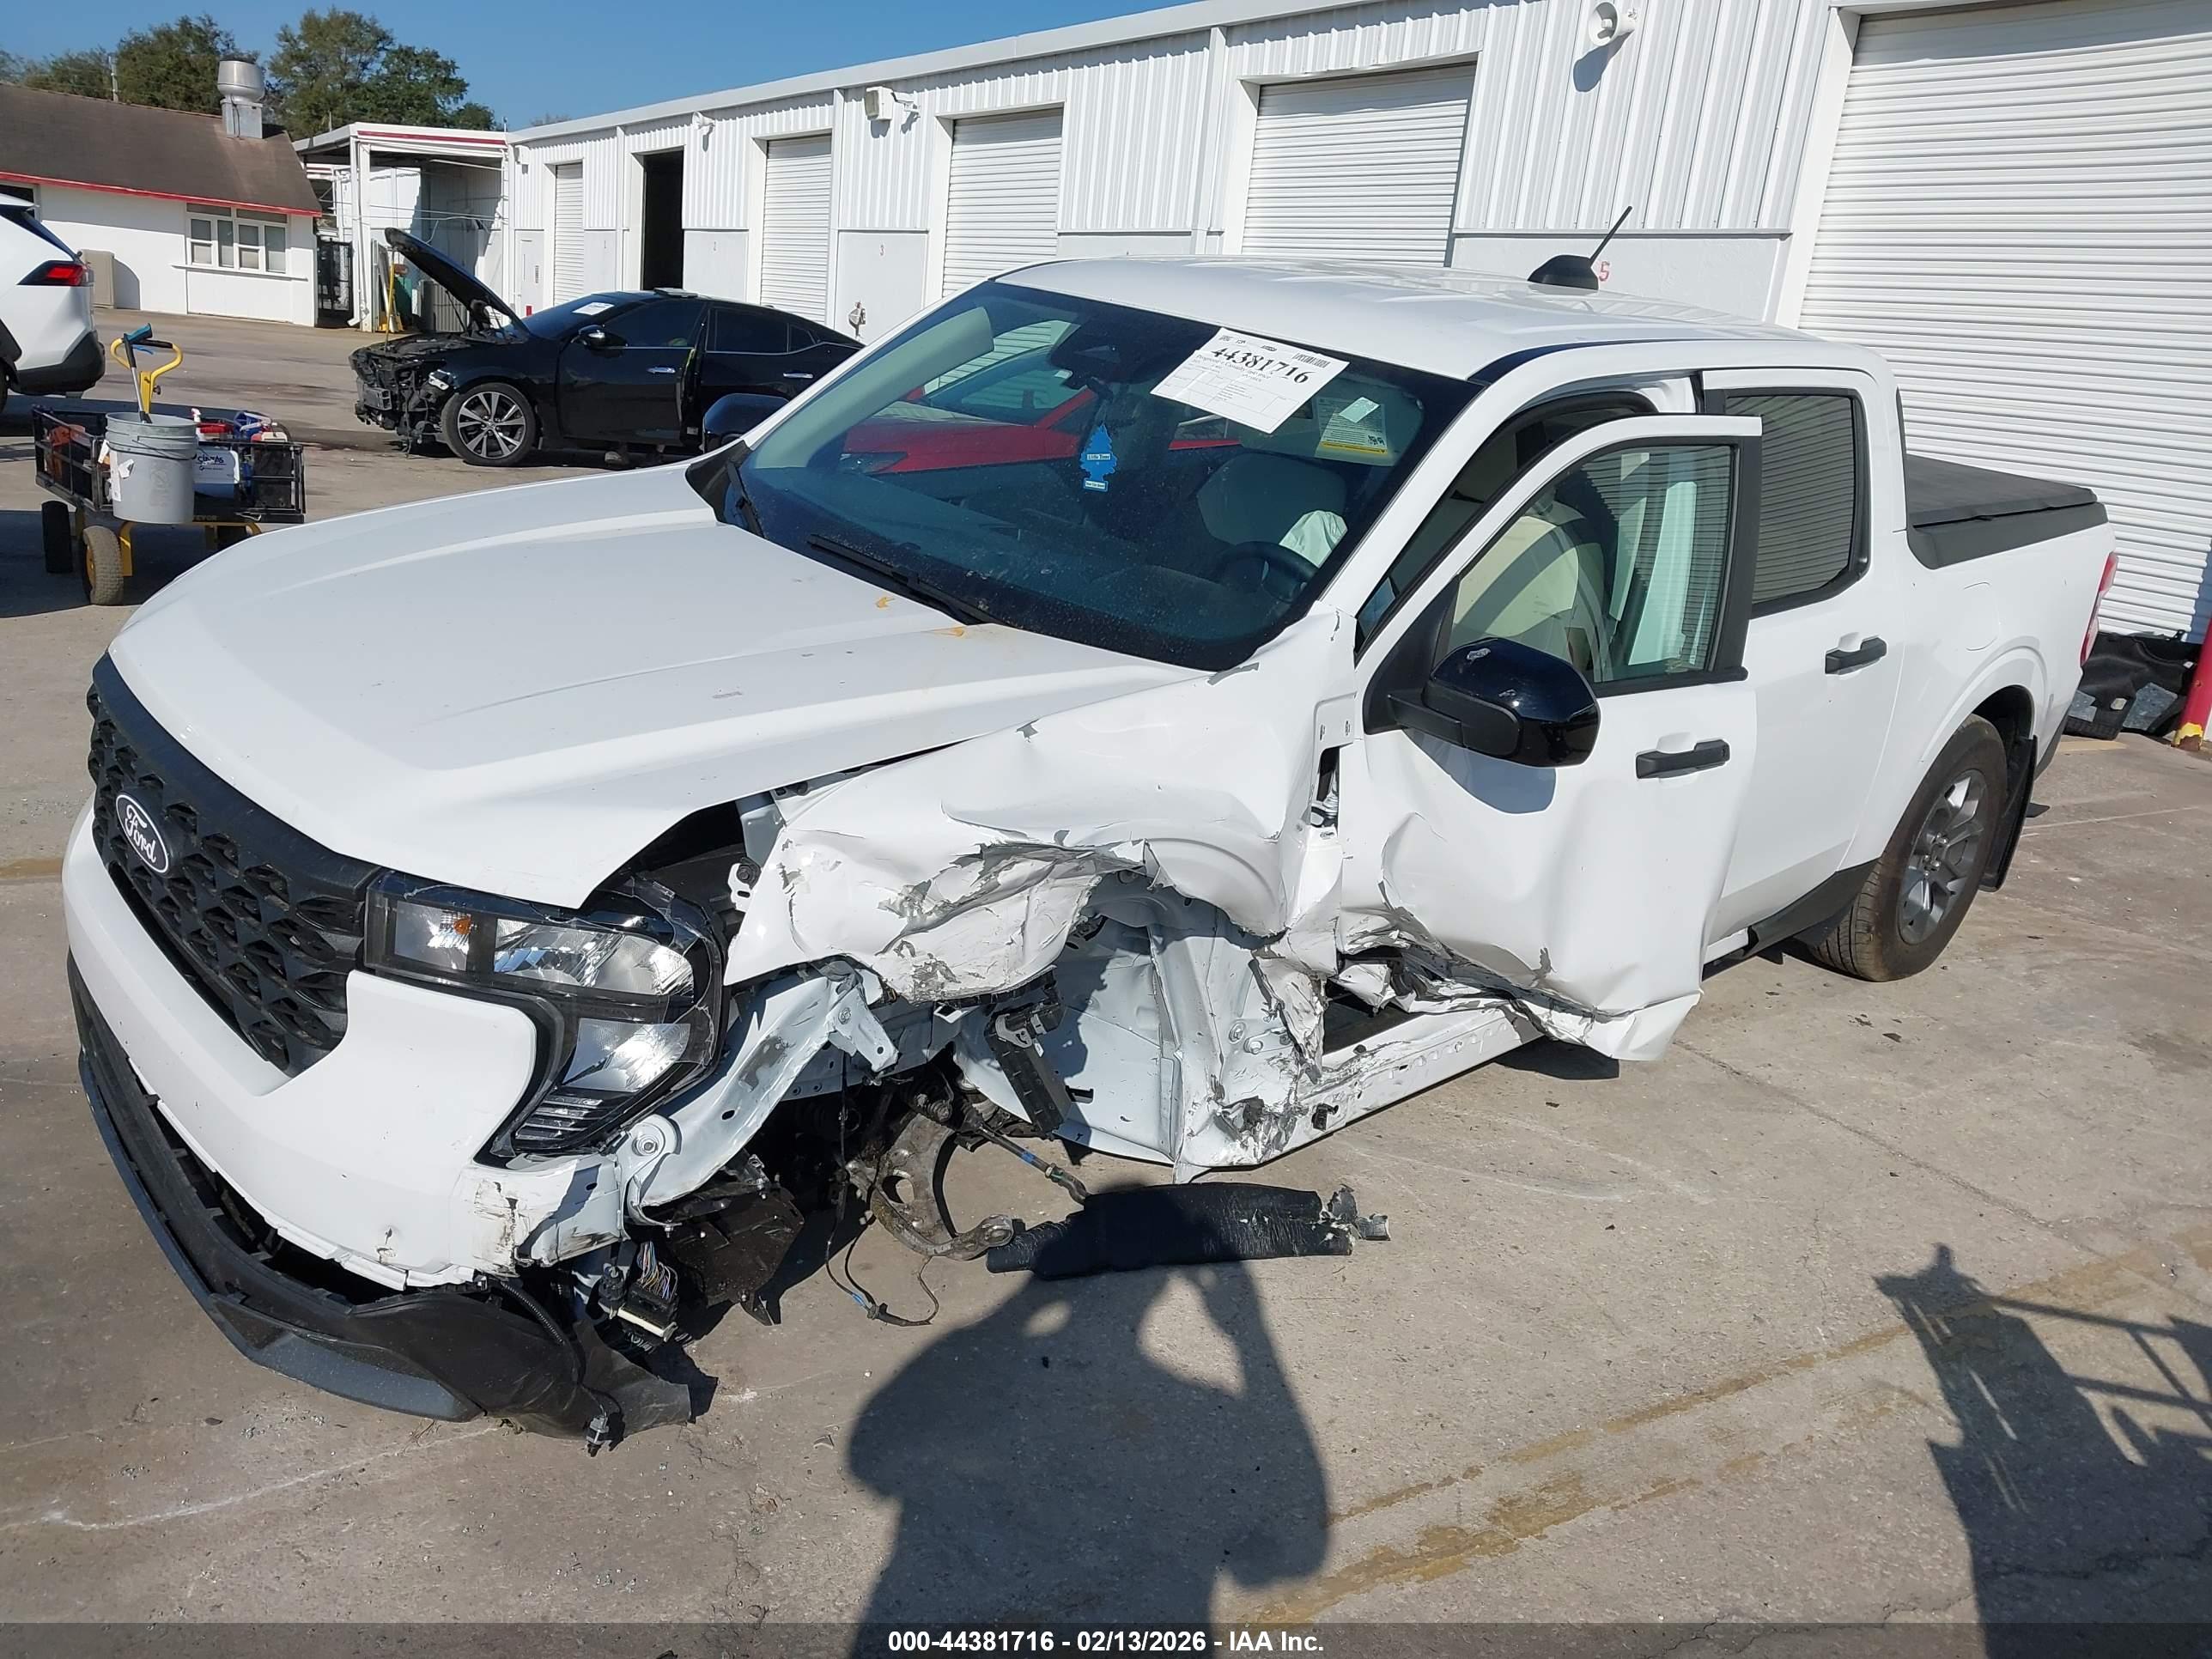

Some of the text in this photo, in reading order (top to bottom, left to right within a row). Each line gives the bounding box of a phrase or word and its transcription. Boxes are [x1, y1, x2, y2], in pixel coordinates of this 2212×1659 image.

[1598, 260, 1611, 282] 5
[1211, 346, 1316, 385] 44381716
[125, 804, 157, 864] Ford
